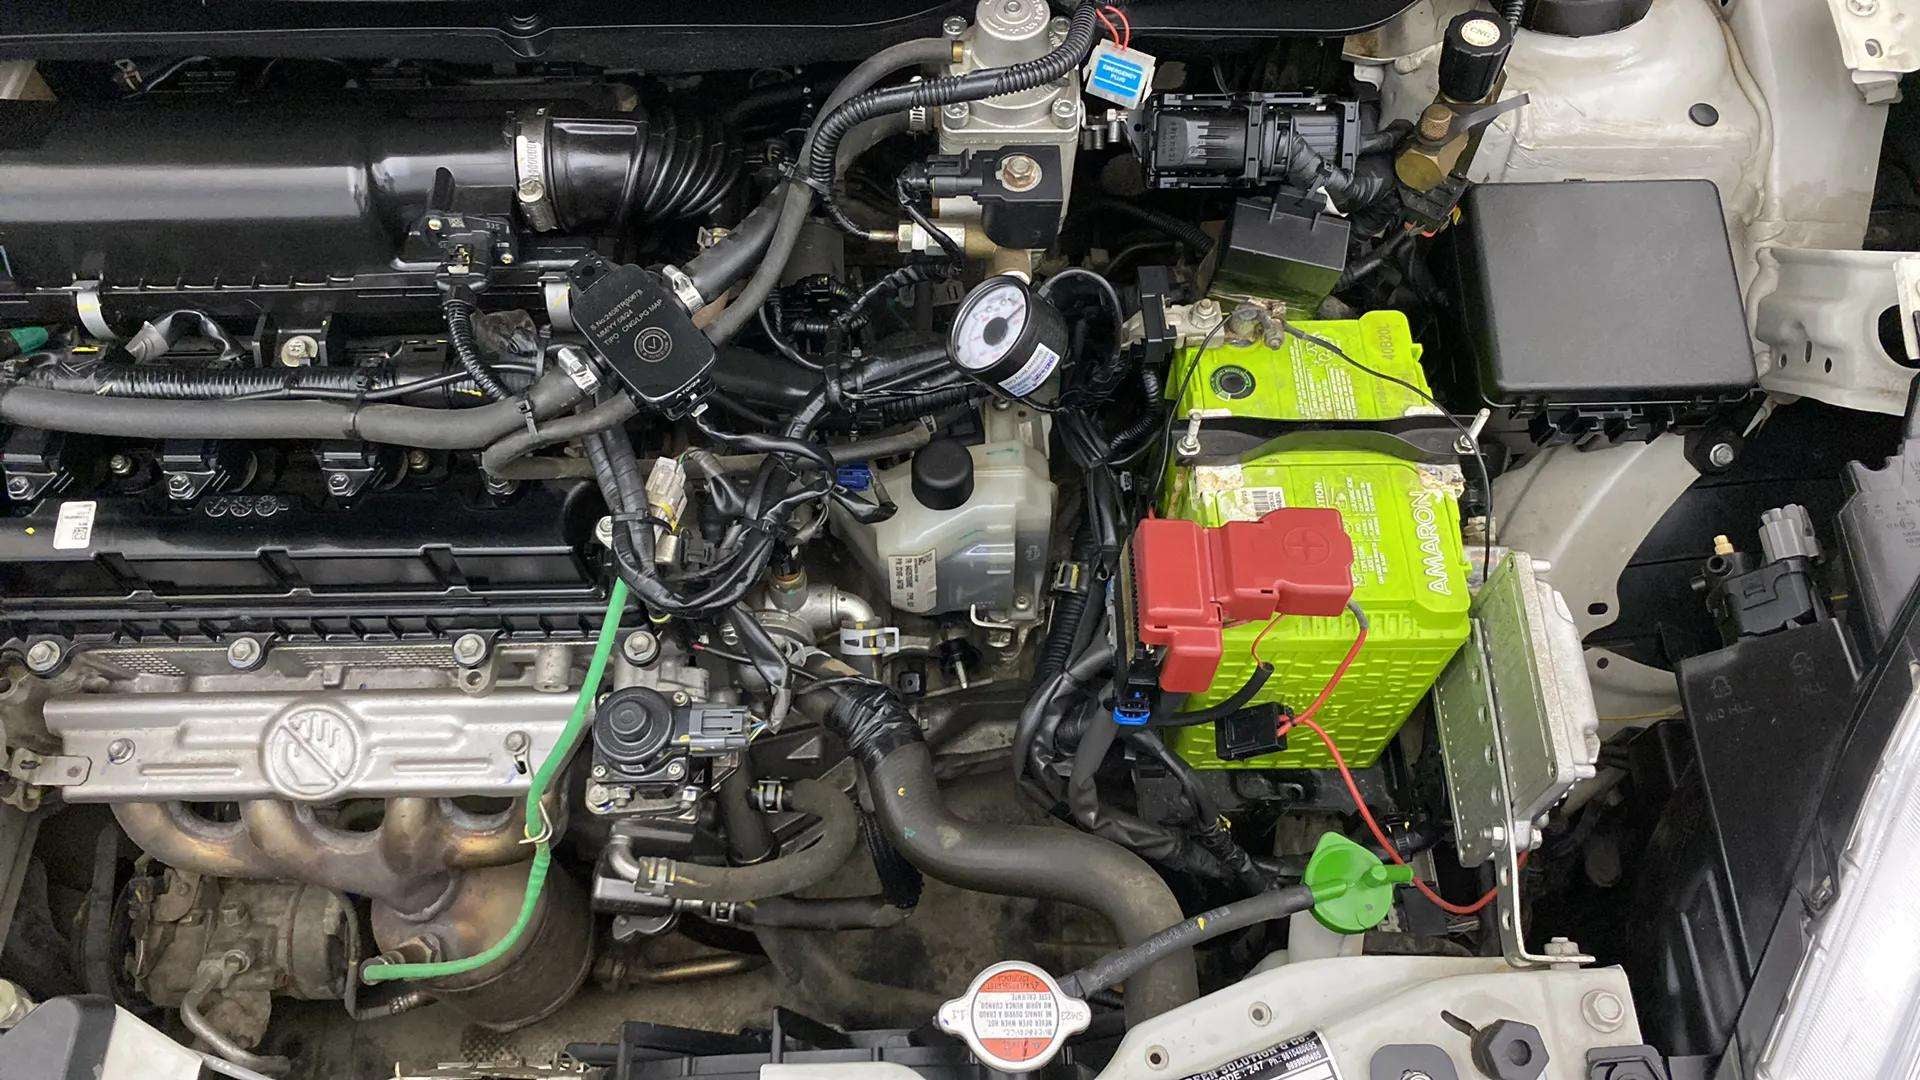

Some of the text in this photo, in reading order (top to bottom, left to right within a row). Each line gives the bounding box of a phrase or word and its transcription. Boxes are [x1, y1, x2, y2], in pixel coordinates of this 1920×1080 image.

[1102, 64, 1137, 80] EMERGENCY
[604, 333, 620, 346] TIPO
[648, 298, 662, 313] MAP
[1409, 490, 1452, 596] AMARON
[1000, 1019, 1017, 1027] WHEN
[1018, 1019, 1033, 1027] OPEN
[1034, 1019, 1052, 1027] NEVER
[1221, 1048, 1278, 1074] SOLUTION
[1249, 1061, 1264, 1074] 247
